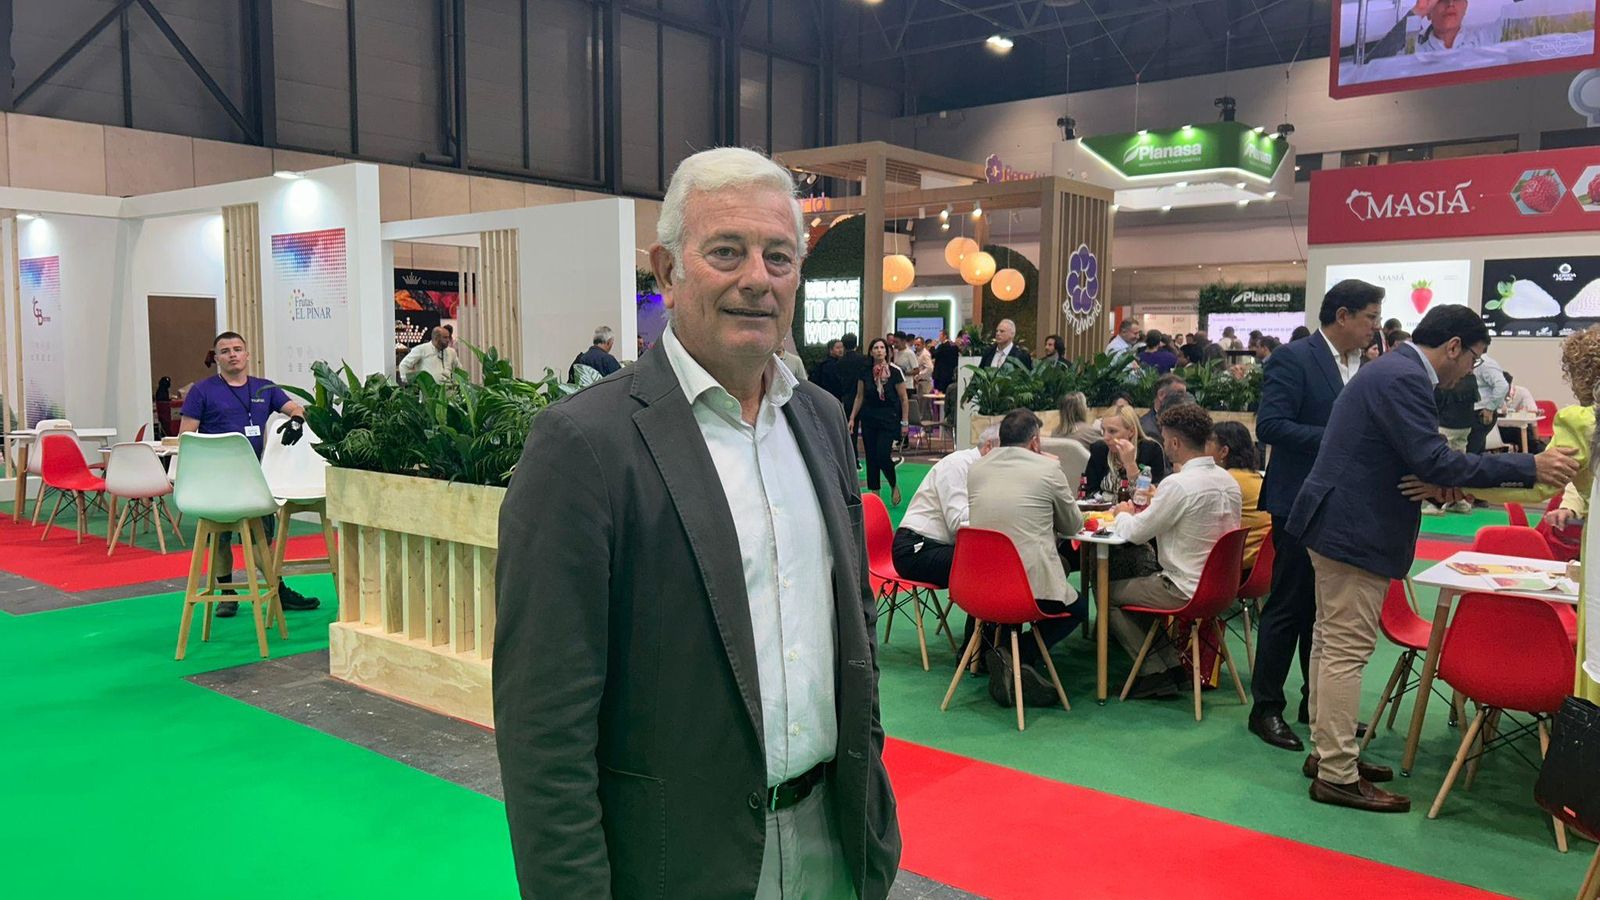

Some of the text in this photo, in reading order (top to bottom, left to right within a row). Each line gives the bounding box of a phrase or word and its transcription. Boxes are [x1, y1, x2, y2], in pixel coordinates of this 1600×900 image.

[1138, 143, 1202, 161] Planasa
[295, 297, 314, 307] Frutas
[1243, 291, 1291, 303] Planasa
[295, 307, 331, 320] EL PINAR
[805, 298, 859, 321] TO OUR
